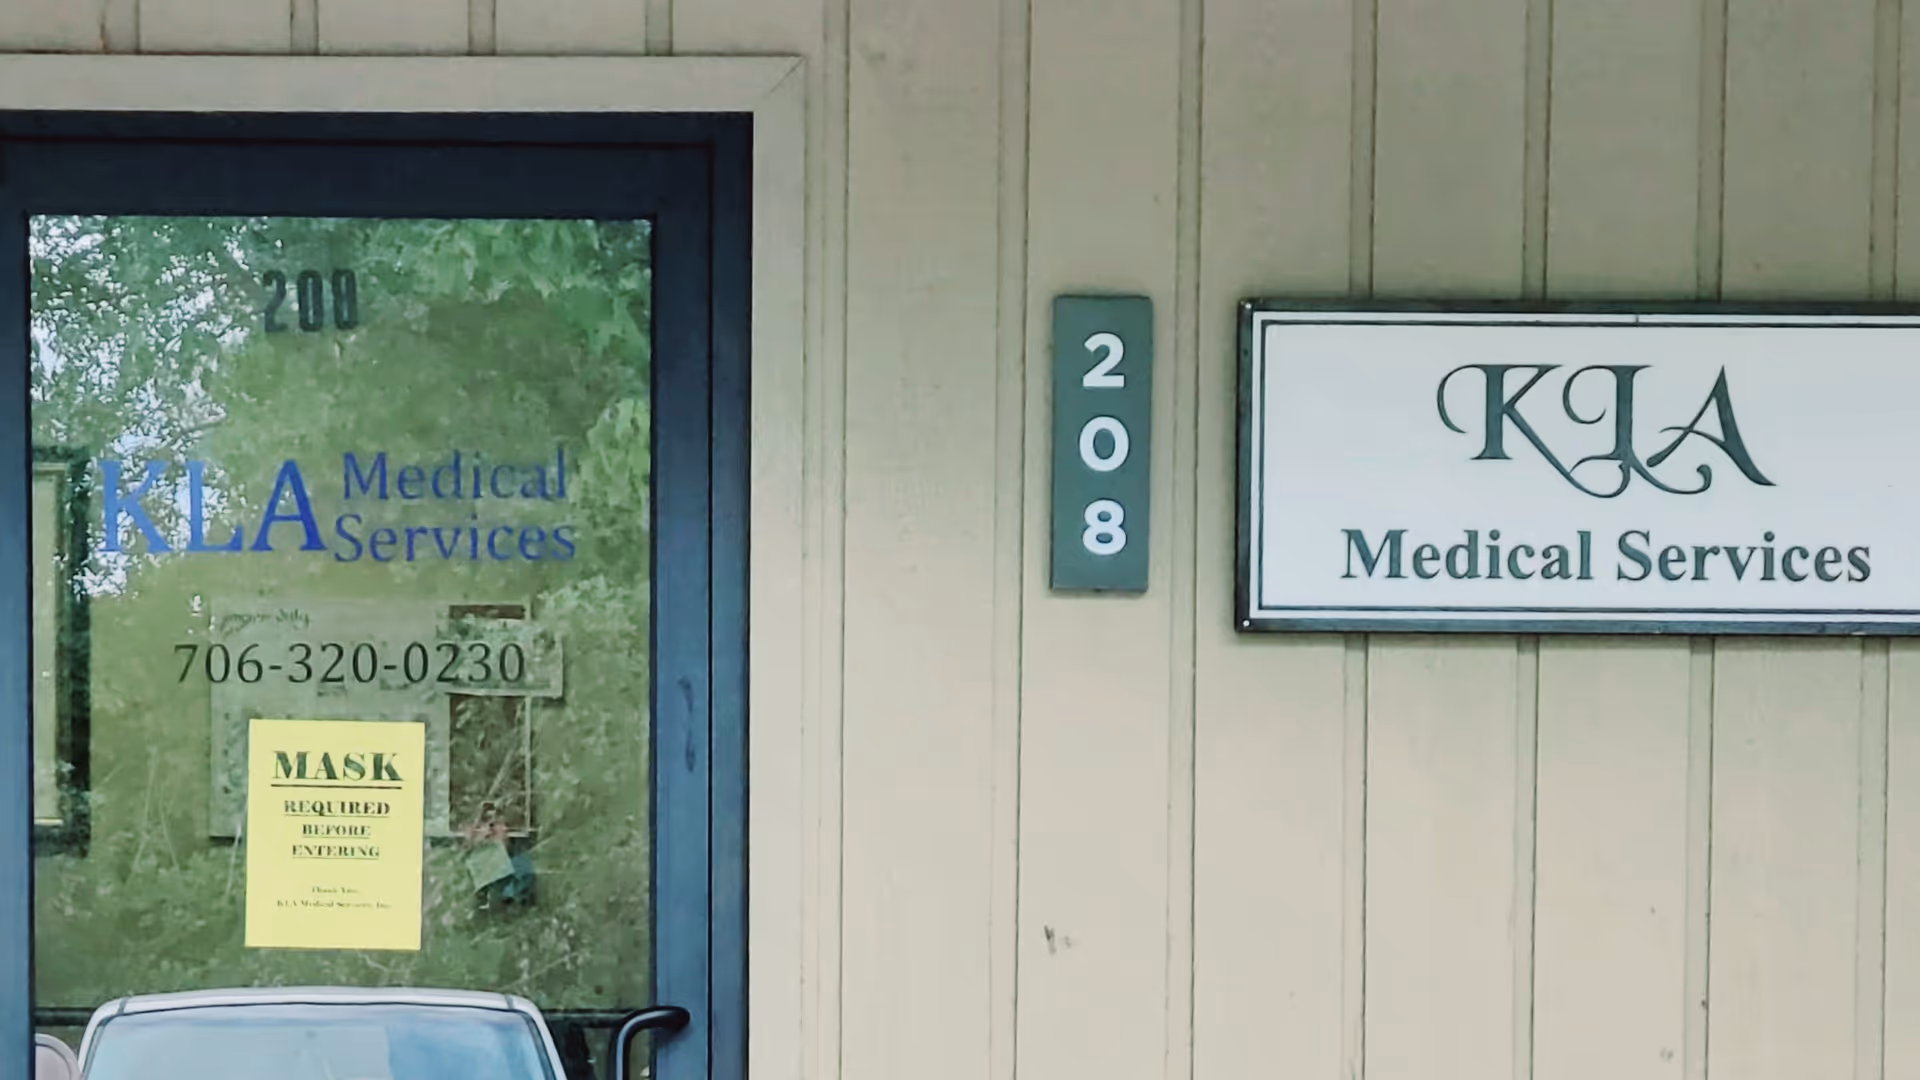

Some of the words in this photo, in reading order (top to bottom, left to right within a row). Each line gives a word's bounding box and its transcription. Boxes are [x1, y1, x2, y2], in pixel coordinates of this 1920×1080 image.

[1437, 363, 1777, 498] KLA
[99, 459, 328, 552] KLA
[343, 446, 567, 501] Medical
[334, 513, 577, 562] Services
[1341, 529, 1594, 581] Medical
[1616, 529, 1872, 583] Services
[173, 642, 526, 685] 706-320-0230
[271, 750, 404, 782] MASK
[284, 799, 391, 816] REQUIRED
[292, 844, 380, 858] ENTERING
[302, 823, 371, 836] BEFORE
